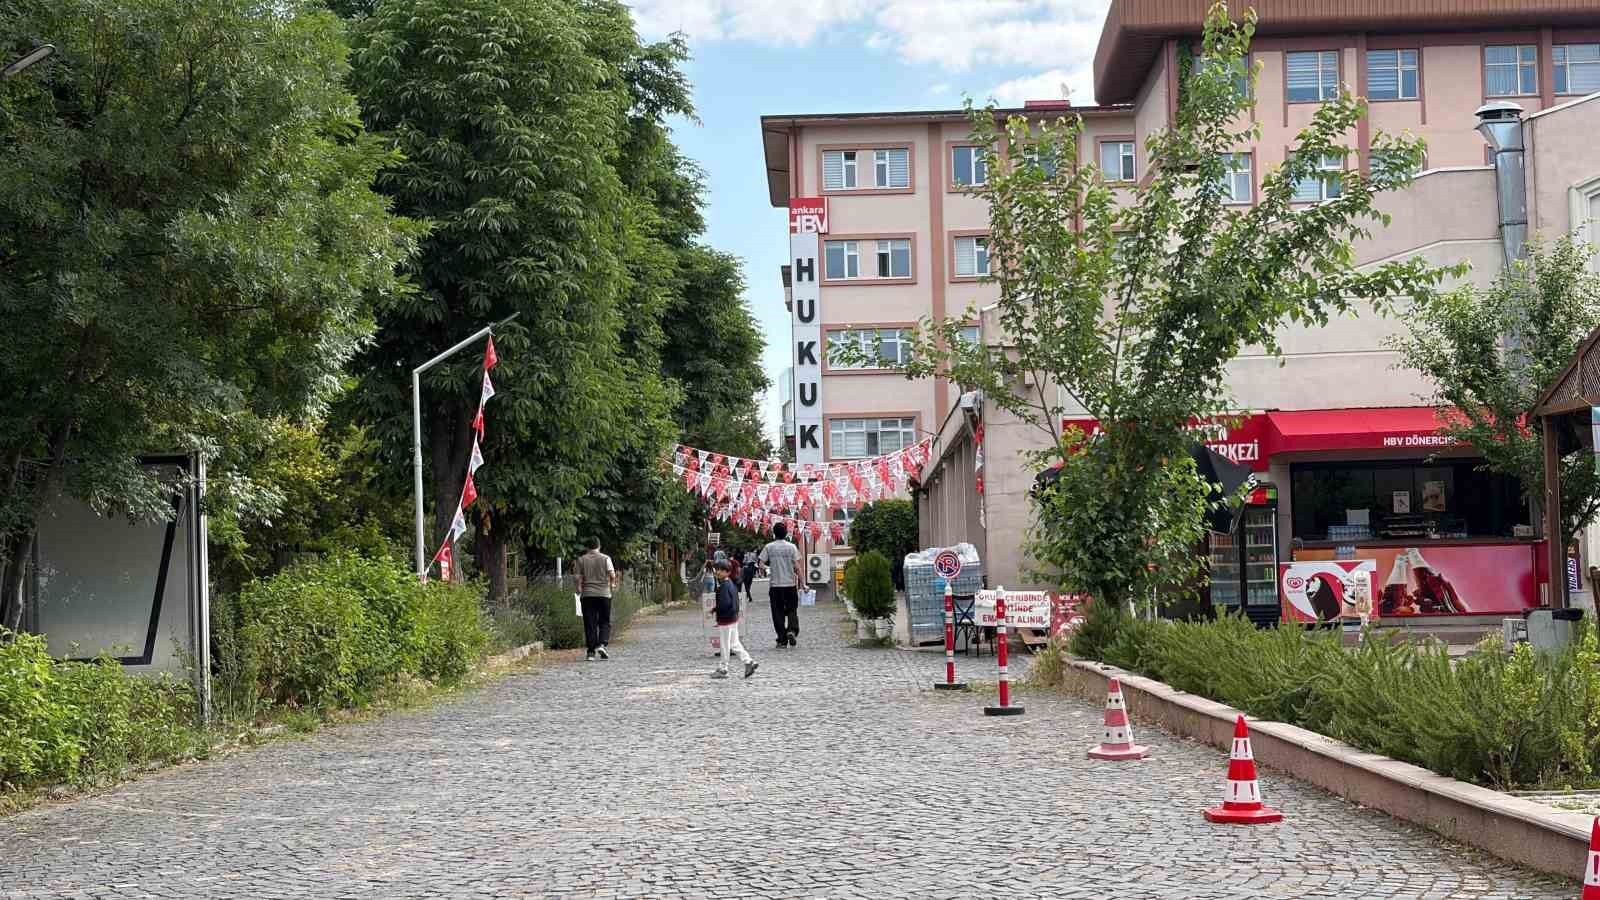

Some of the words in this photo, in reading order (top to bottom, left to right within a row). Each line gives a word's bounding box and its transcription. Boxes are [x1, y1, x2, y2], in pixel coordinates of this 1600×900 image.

[791, 206, 824, 215] ankara
[796, 258, 820, 449] HUKUK
[1384, 436, 1403, 446] HBV
[1206, 439, 1259, 462] RKEZİ
